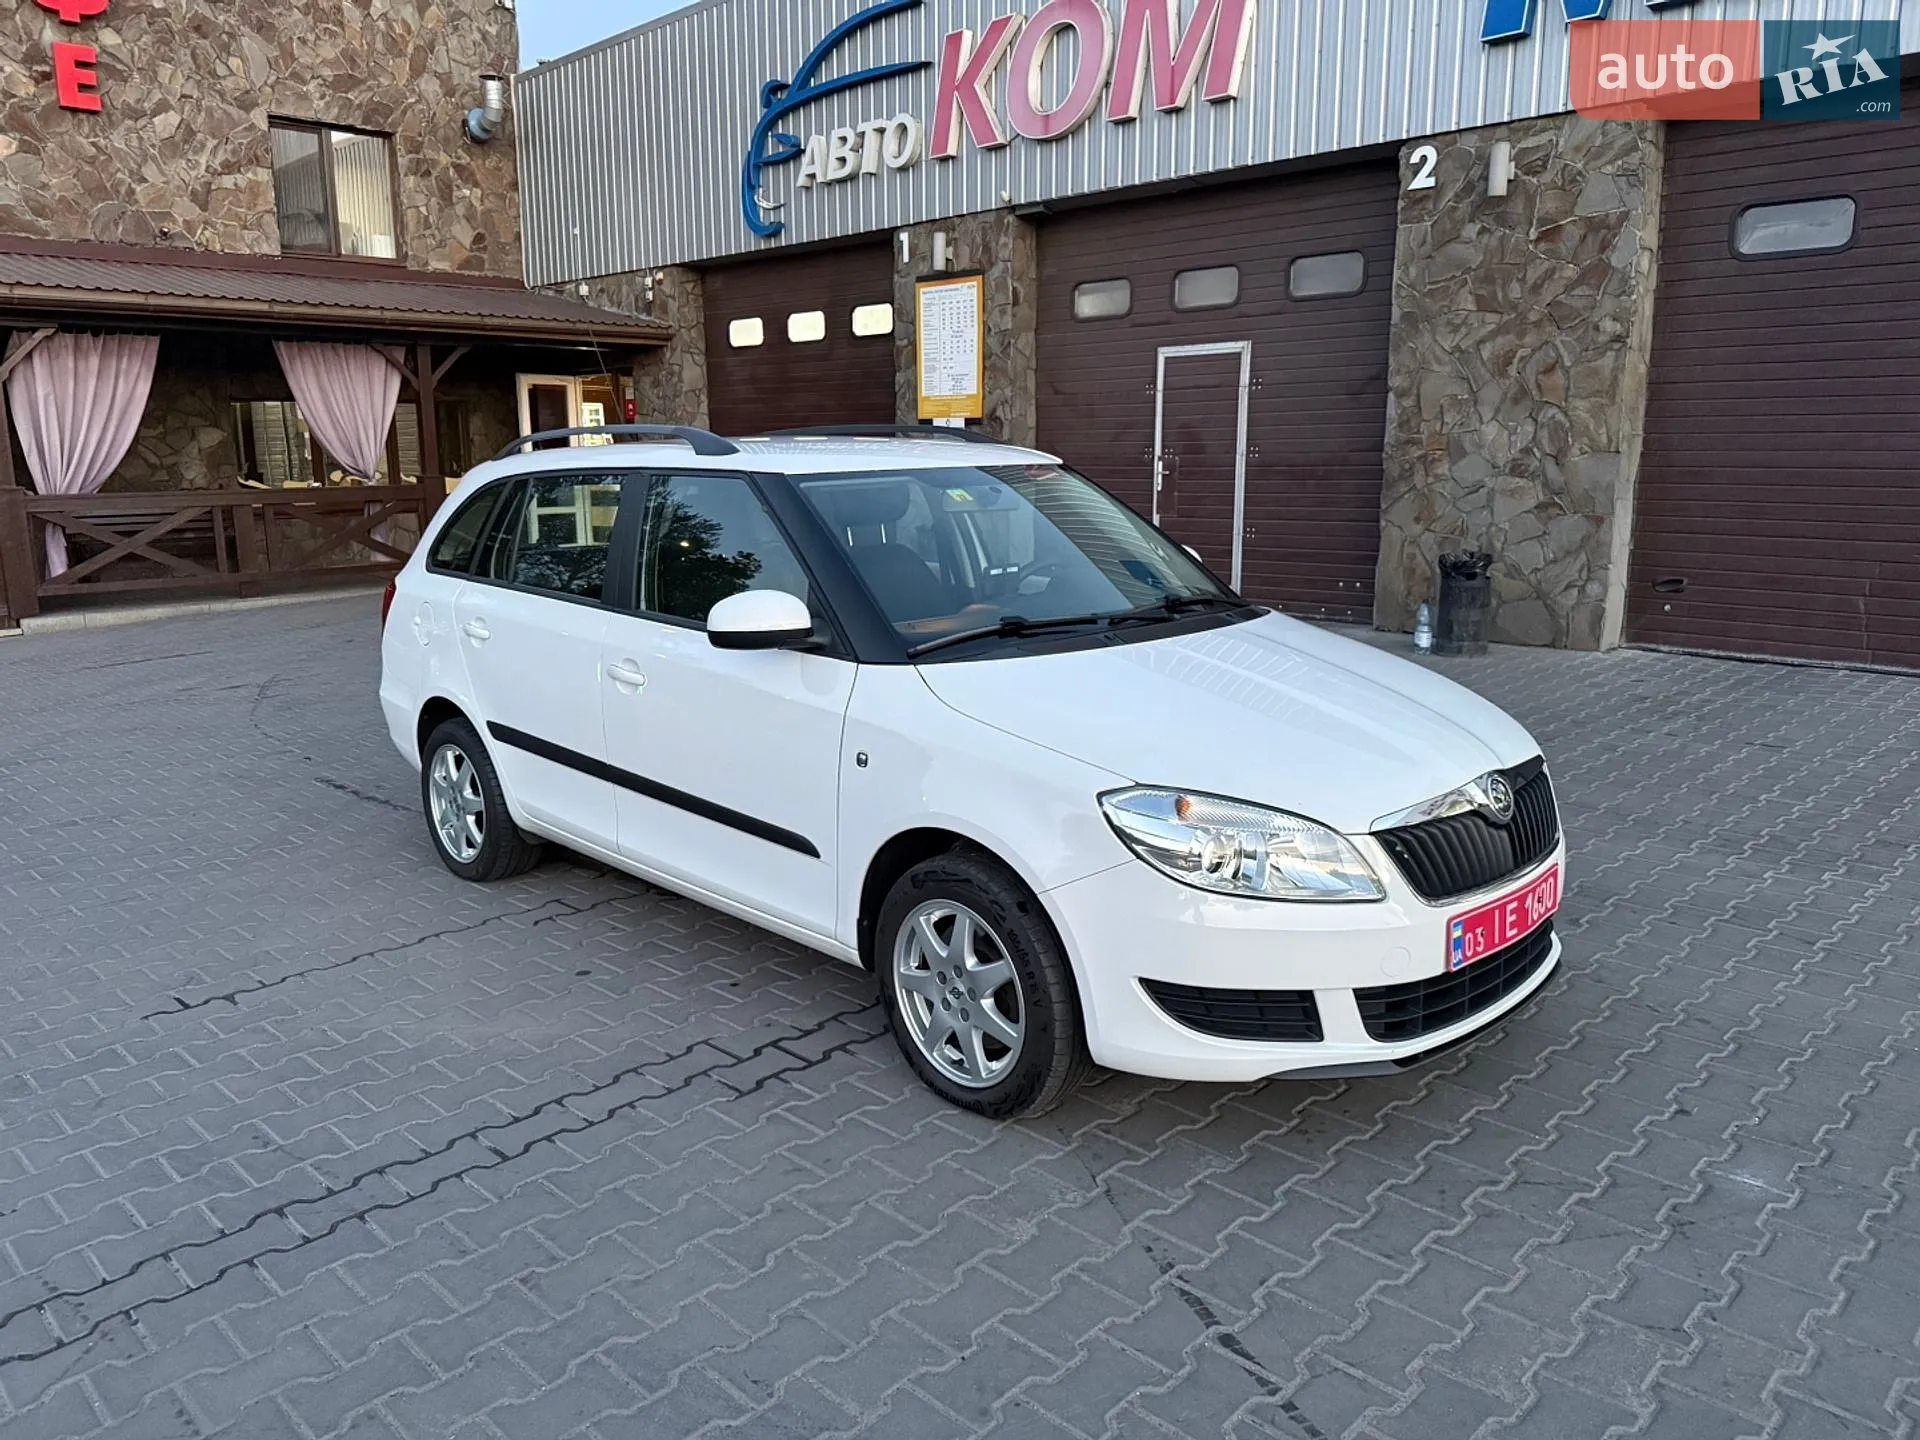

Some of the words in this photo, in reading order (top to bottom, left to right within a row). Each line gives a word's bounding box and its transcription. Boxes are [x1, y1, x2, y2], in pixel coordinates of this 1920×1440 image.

[796, 113, 922, 188] АВТО
[929, 0, 1258, 160] КОМ
[1407, 145, 1439, 190] 2
[898, 231, 910, 263] 1
[1465, 926, 1485, 957] 03
